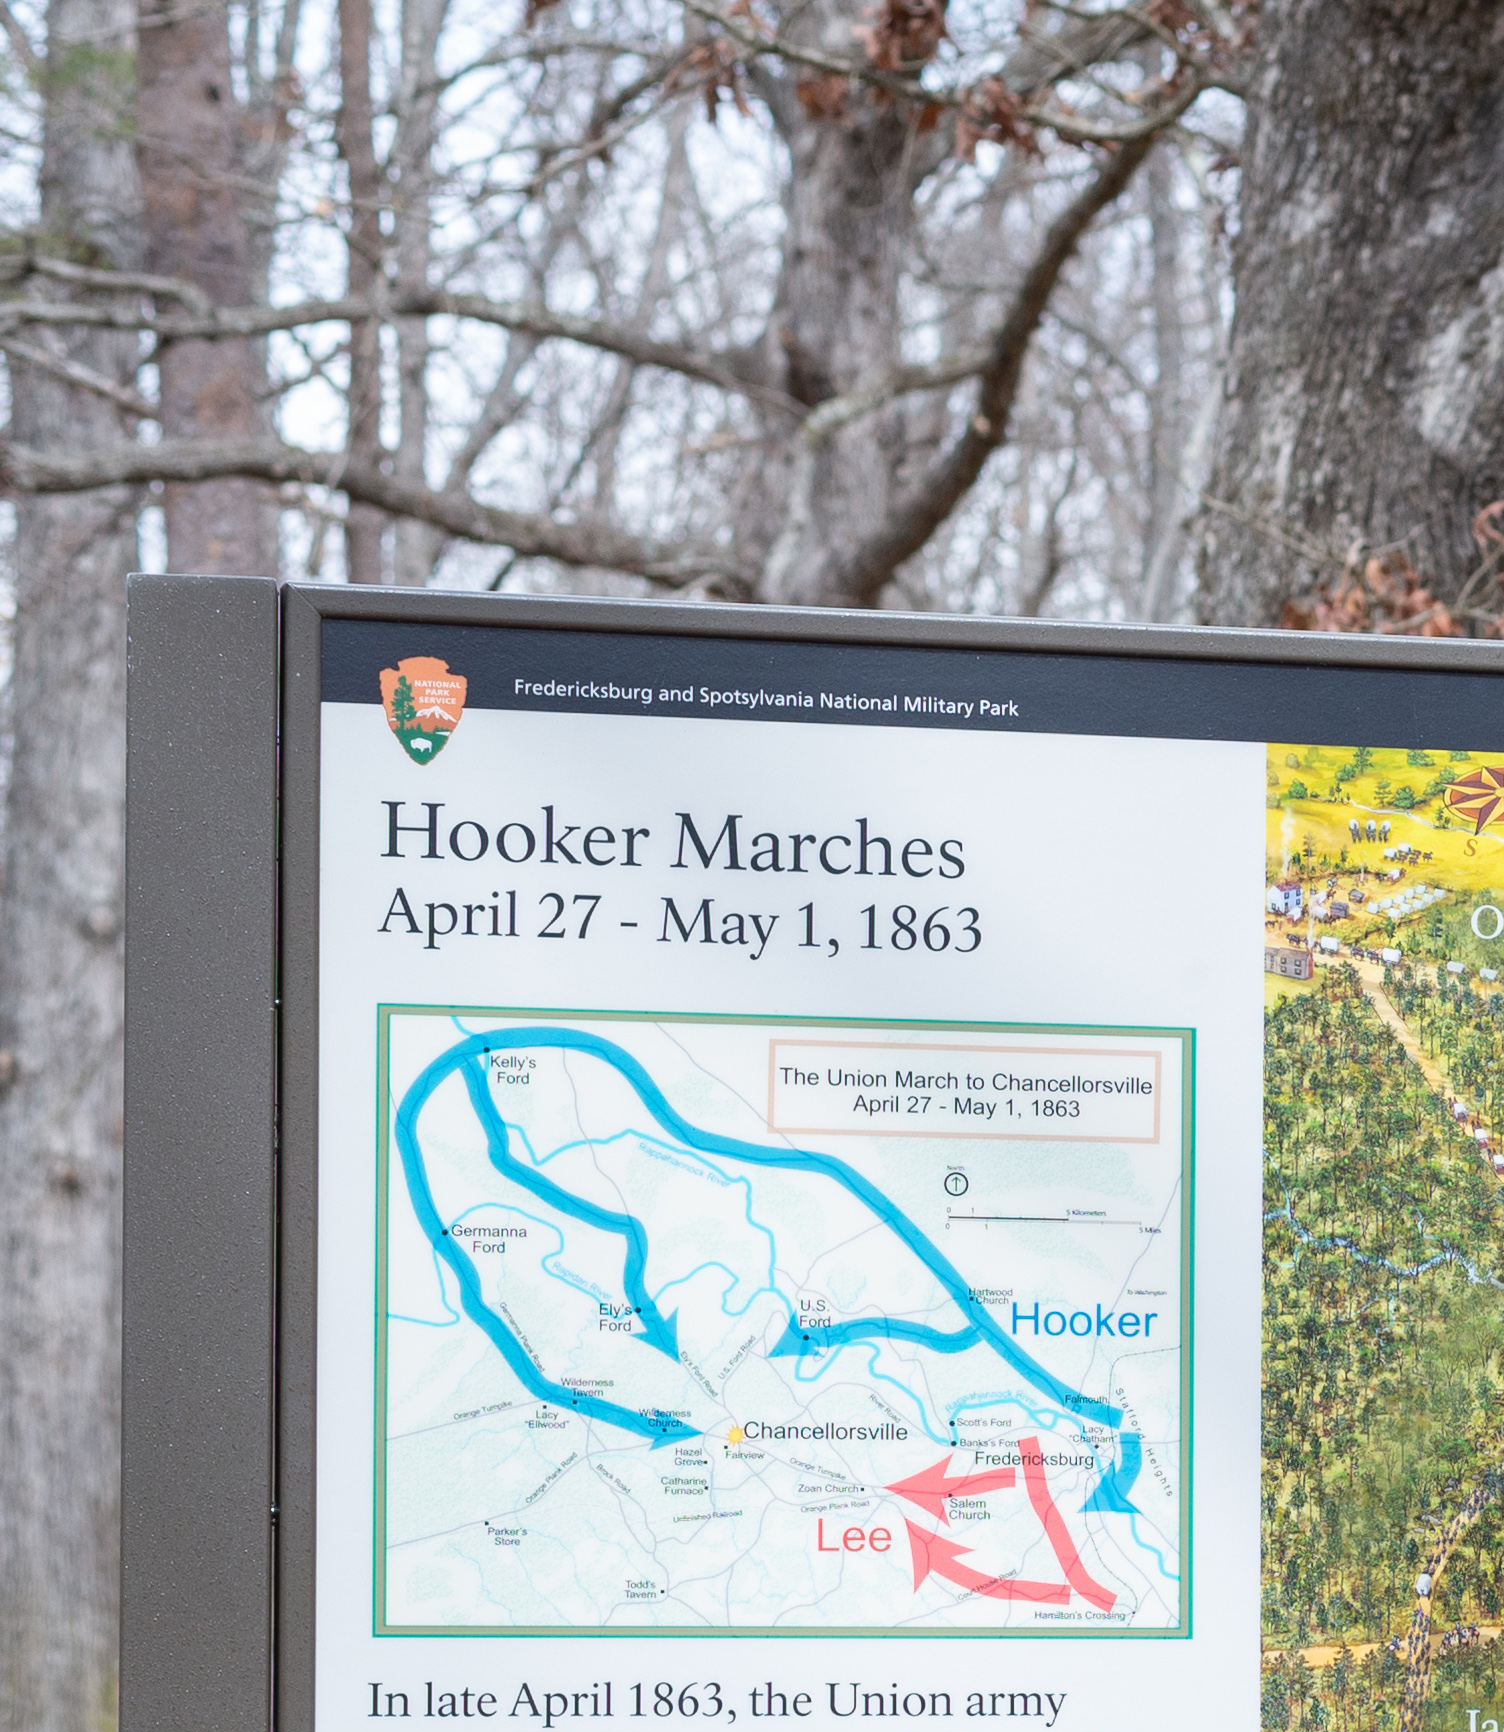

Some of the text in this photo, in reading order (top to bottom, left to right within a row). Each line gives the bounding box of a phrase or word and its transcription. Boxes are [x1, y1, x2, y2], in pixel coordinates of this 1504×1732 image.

[414, 680, 461, 688] NATIONAL
[514, 678, 1019, 719] Fredericksburg and Spotsylvania National Military Park
[380, 800, 965, 880] Hooker Marches
[377, 887, 520, 950] April
[537, 892, 602, 939] 27
[656, 896, 780, 961] May
[798, 901, 840, 958] 1,
[860, 903, 982, 953] 1863
[497, 1073, 529, 1084] Ford
[779, 1067, 1153, 1095] The Union March to Chancellorsville
[852, 1094, 899, 1117] April
[906, 1095, 932, 1114] 27
[954, 1096, 997, 1121] May
[1005, 1098, 1022, 1119] 1,
[1031, 1099, 1081, 1118] 1863
[451, 1225, 527, 1238] Germanna
[473, 1241, 505, 1253] Ford
[969, 1287, 1013, 1296] Hartwood
[800, 1300, 829, 1311] U.S.
[976, 1296, 1009, 1304] Church
[800, 1316, 830, 1327] Ford
[1011, 1301, 1158, 1338] Hooker
[600, 1320, 631, 1331] Ford
[561, 1378, 614, 1387] Wilderness
[1065, 1395, 1107, 1404] Falmouth
[743, 1421, 908, 1441] Chancellorsville
[675, 1448, 702, 1456] Hazel
[975, 1452, 1094, 1468] Fredericksburg
[798, 1485, 858, 1494] Zoan Church
[950, 1499, 986, 1509] Salem
[949, 1510, 990, 1520] Church
[817, 1518, 892, 1551] Lee
[495, 1537, 520, 1546] Store
[625, 1591, 656, 1599] Tavern
[367, 1681, 1068, 1729] In late April 1863, the Union army
